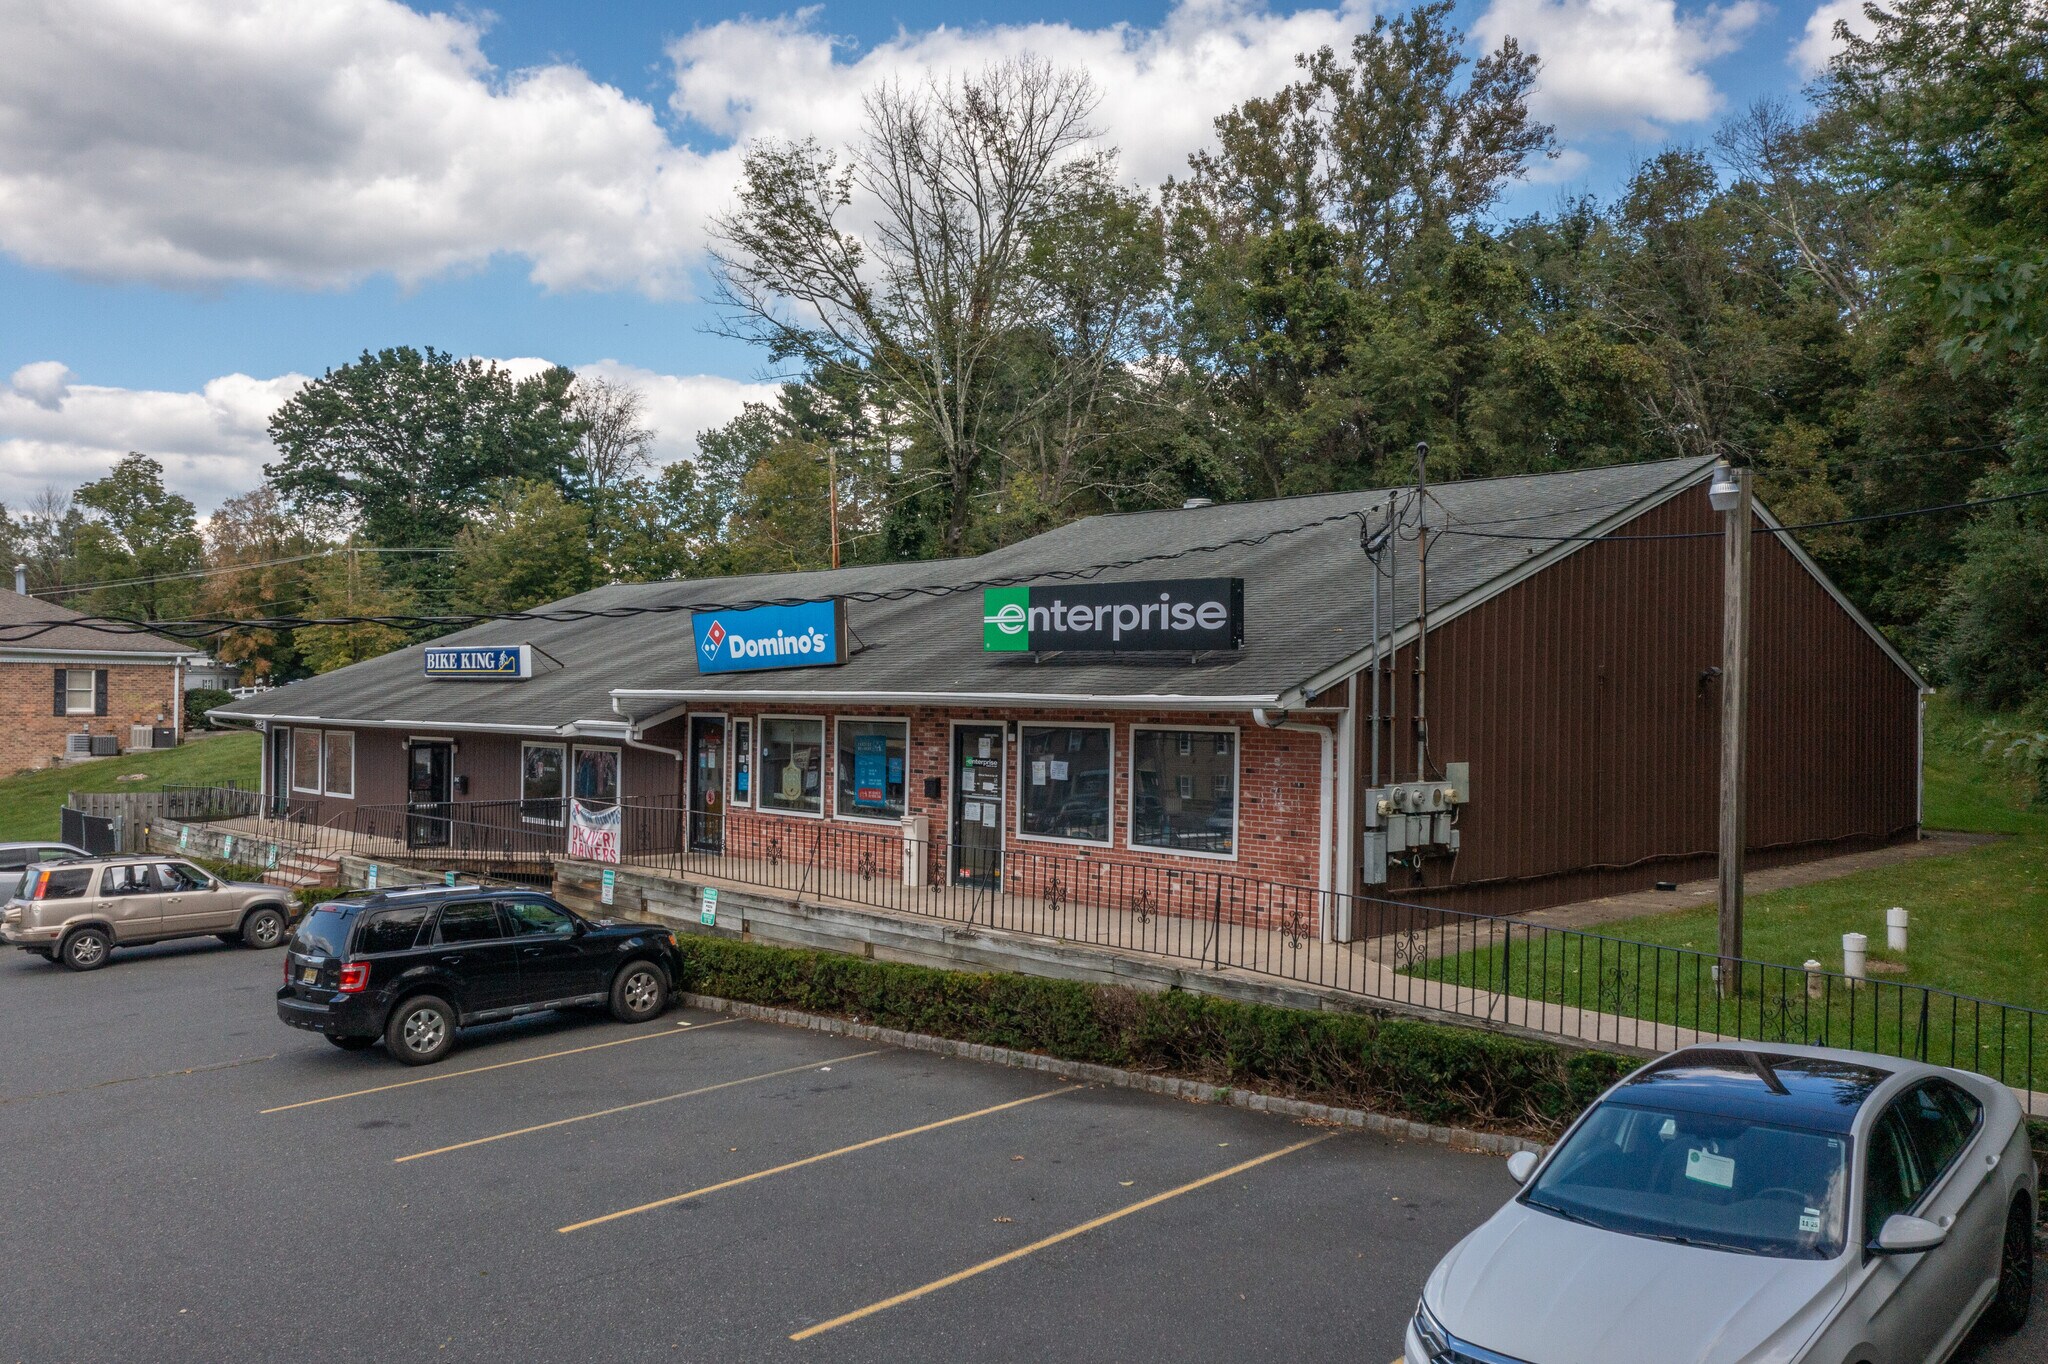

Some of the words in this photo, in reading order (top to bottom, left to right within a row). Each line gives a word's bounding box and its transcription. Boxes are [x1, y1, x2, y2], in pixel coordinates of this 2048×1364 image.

[984, 593, 1228, 641] enterprise
[728, 626, 826, 659] Domino's
[427, 653, 457, 669] BIKE
[460, 652, 495, 669] KING
[966, 758, 998, 767] enterprise
